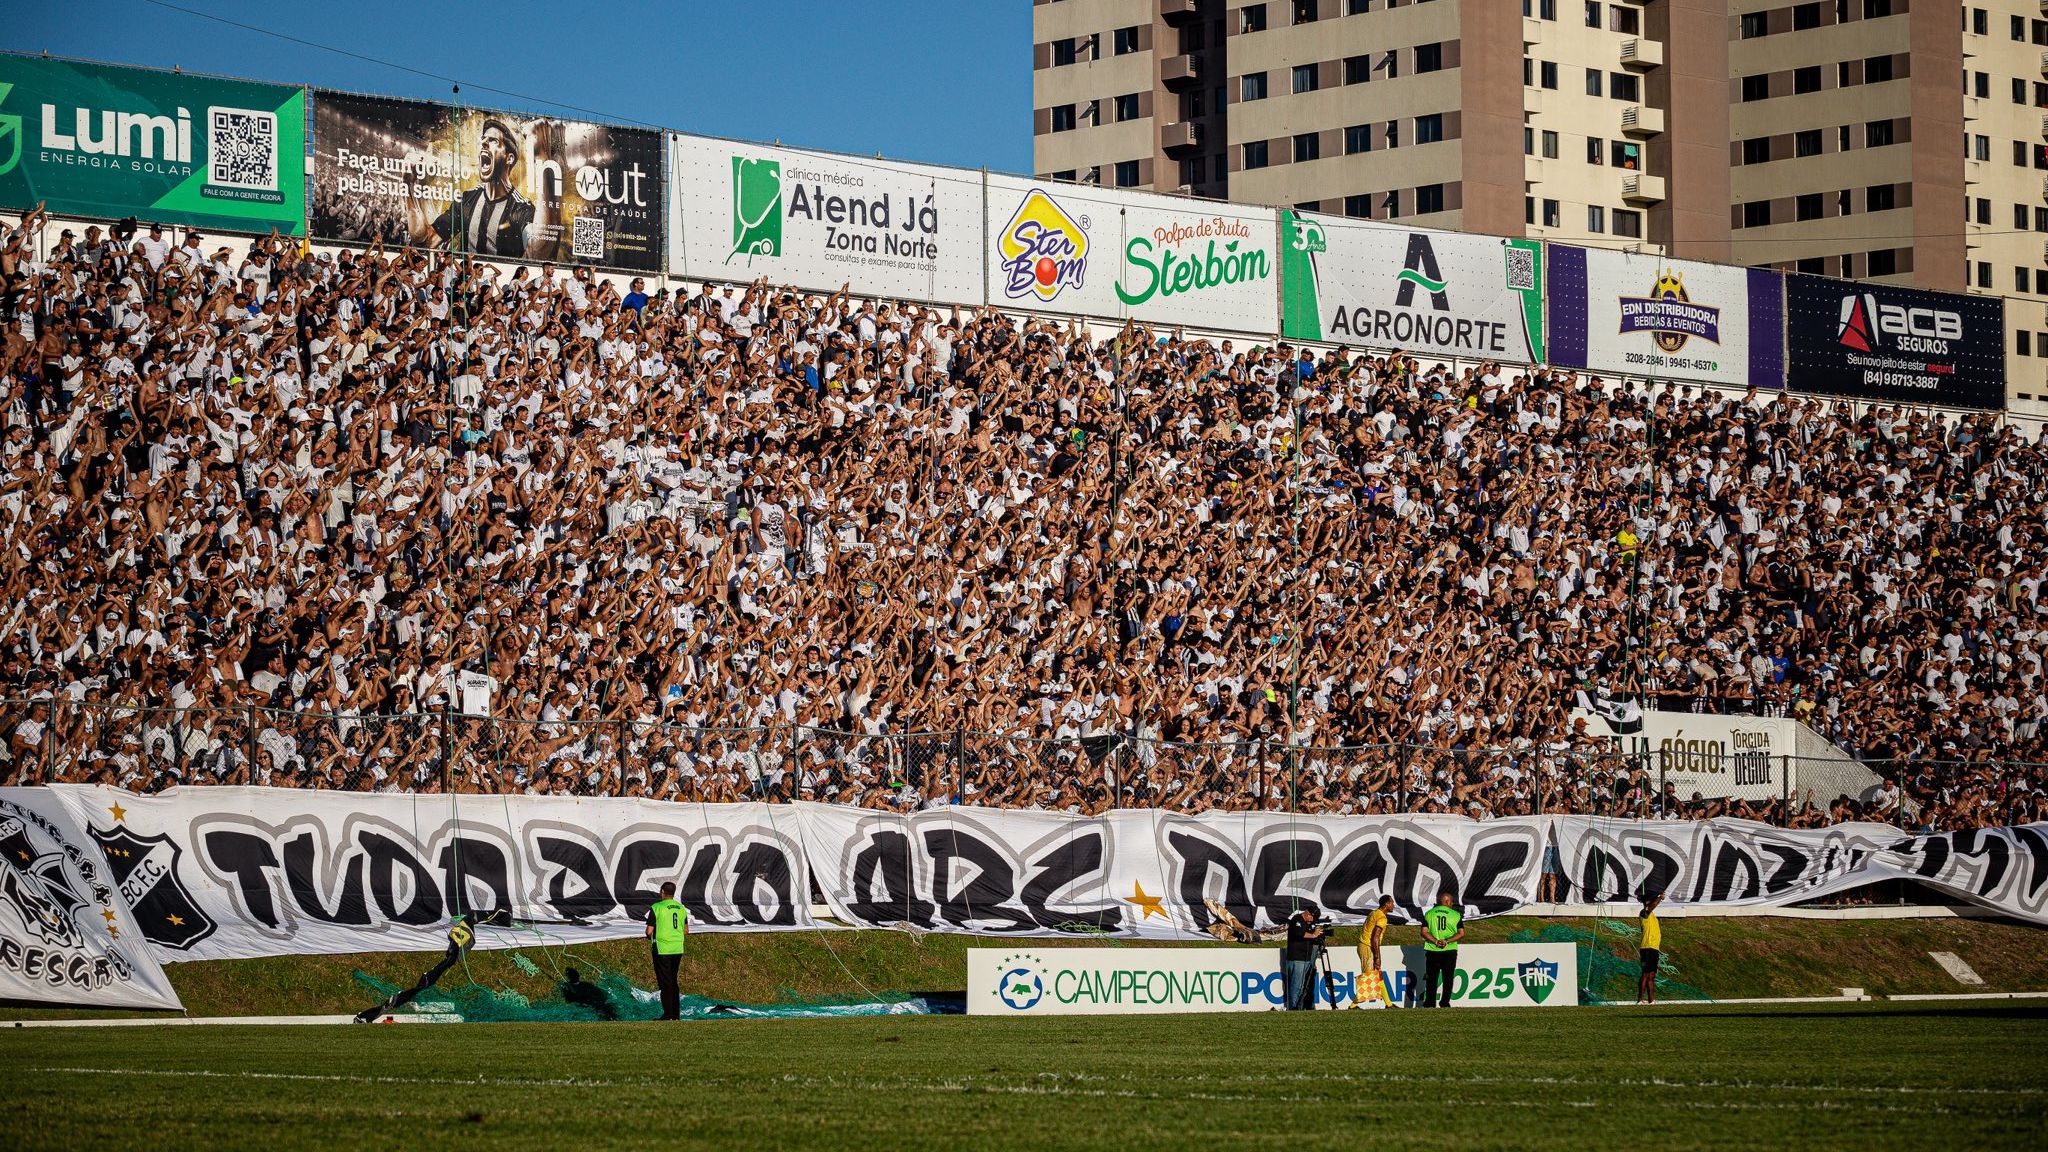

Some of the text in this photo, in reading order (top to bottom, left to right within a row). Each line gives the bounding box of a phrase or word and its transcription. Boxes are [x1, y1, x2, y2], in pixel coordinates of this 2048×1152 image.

[40, 151, 192, 177] ENERGIA SOLAR
[337, 148, 380, 174] Faça
[383, 156, 413, 174] um
[337, 172, 375, 196] pela
[378, 179, 410, 197] sua
[786, 166, 864, 187] clínica médica
[203, 188, 219, 196] FALE
[219, 189, 234, 198] COM
[239, 192, 260, 200] GENTE
[260, 194, 282, 202] AGORA
[524, 198, 647, 219] CRRETORA DE SAÚDE
[788, 183, 938, 235] Atend Já
[825, 226, 938, 260] Zona Norte
[1015, 220, 1076, 263] Ster
[1154, 216, 1251, 249] Polpa de Fruta
[824, 252, 938, 272] consultas e exames para todos
[1622, 302, 1717, 326] EDN DISTRIBUIDORA
[1634, 316, 1706, 334] BEBIDAS & EVENTOS
[1331, 305, 1506, 351] AGRONORTE
[1897, 336, 1949, 355] SEGUROS
[1625, 353, 1712, 371] 3208-2846 99451-4537
[1847, 353, 1956, 374] Seu novo jeito de estar seguro!
[1863, 369, 1940, 389] (84) 9 8713-3887
[1730, 728, 1771, 750] TORCIDA
[1734, 750, 1772, 785] DECIDE
[1436, 915, 1447, 931] 10
[1055, 969, 1241, 1004] CAMPEONATO
[1526, 967, 1551, 987] FNF
